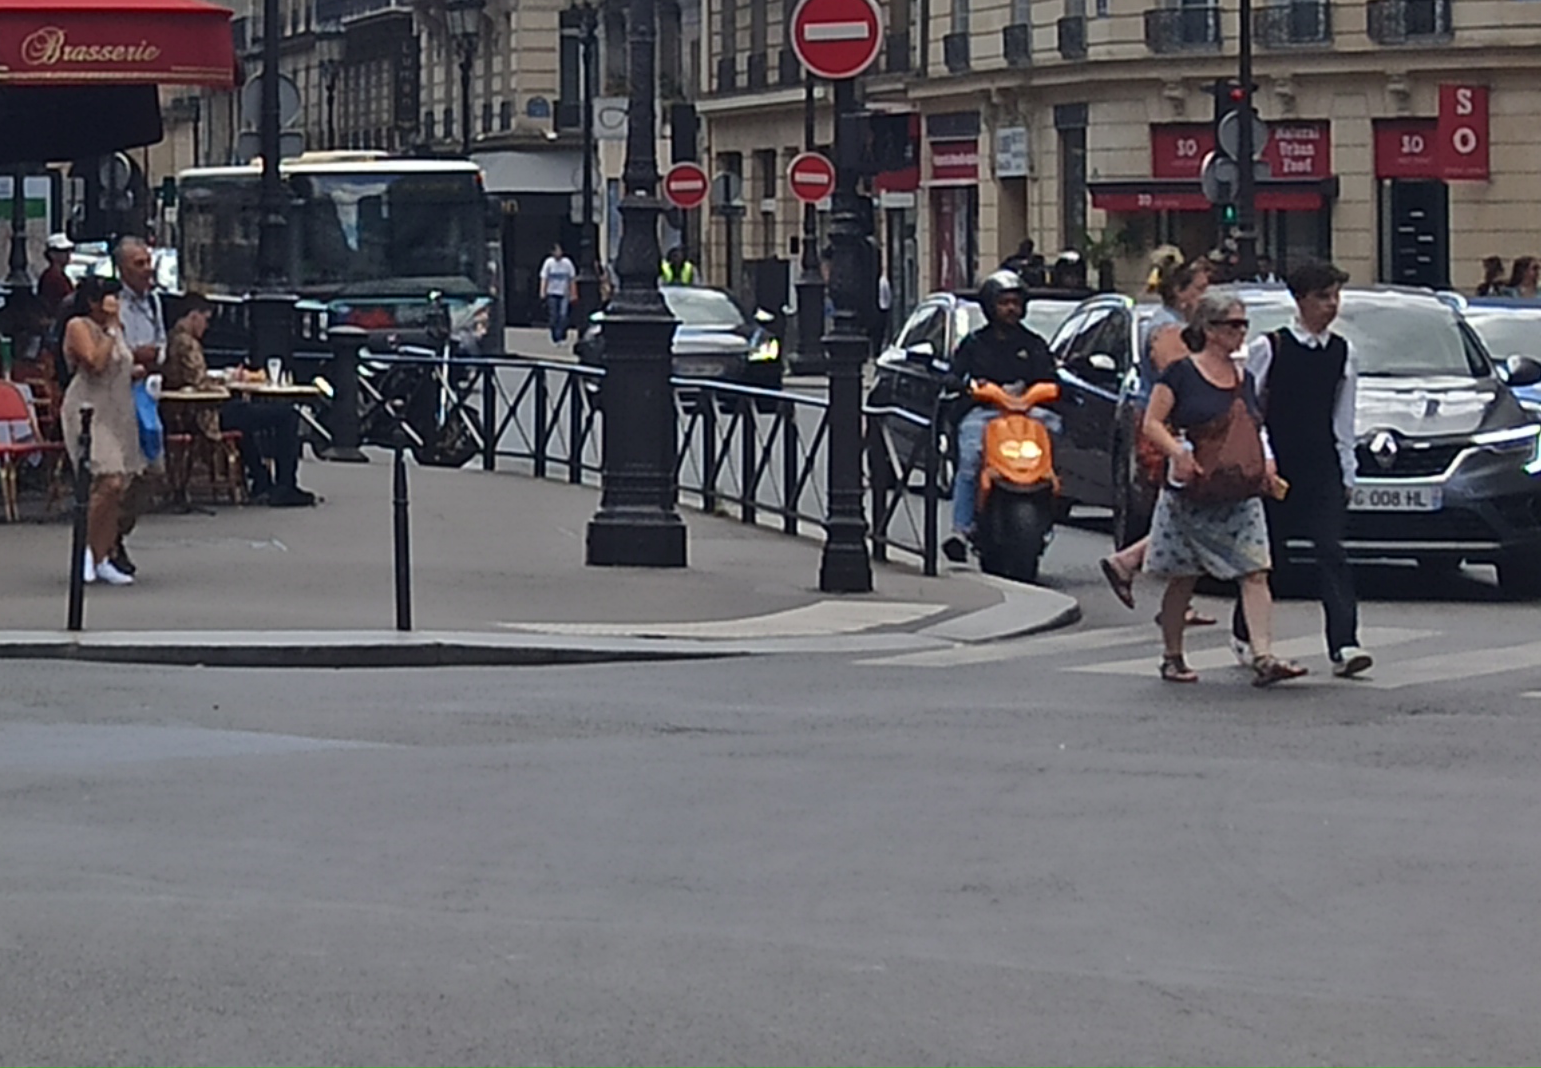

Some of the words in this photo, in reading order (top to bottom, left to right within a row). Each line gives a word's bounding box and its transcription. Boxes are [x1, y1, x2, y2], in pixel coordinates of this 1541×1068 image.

[21, 26, 162, 66] Brasserie
[1177, 139, 1197, 157] SO
[1278, 142, 1315, 156] Urban
[1401, 135, 1424, 153] SO
[1282, 157, 1312, 173] Food
[1370, 490, 1401, 507] 008
[1406, 490, 1427, 507] HL
